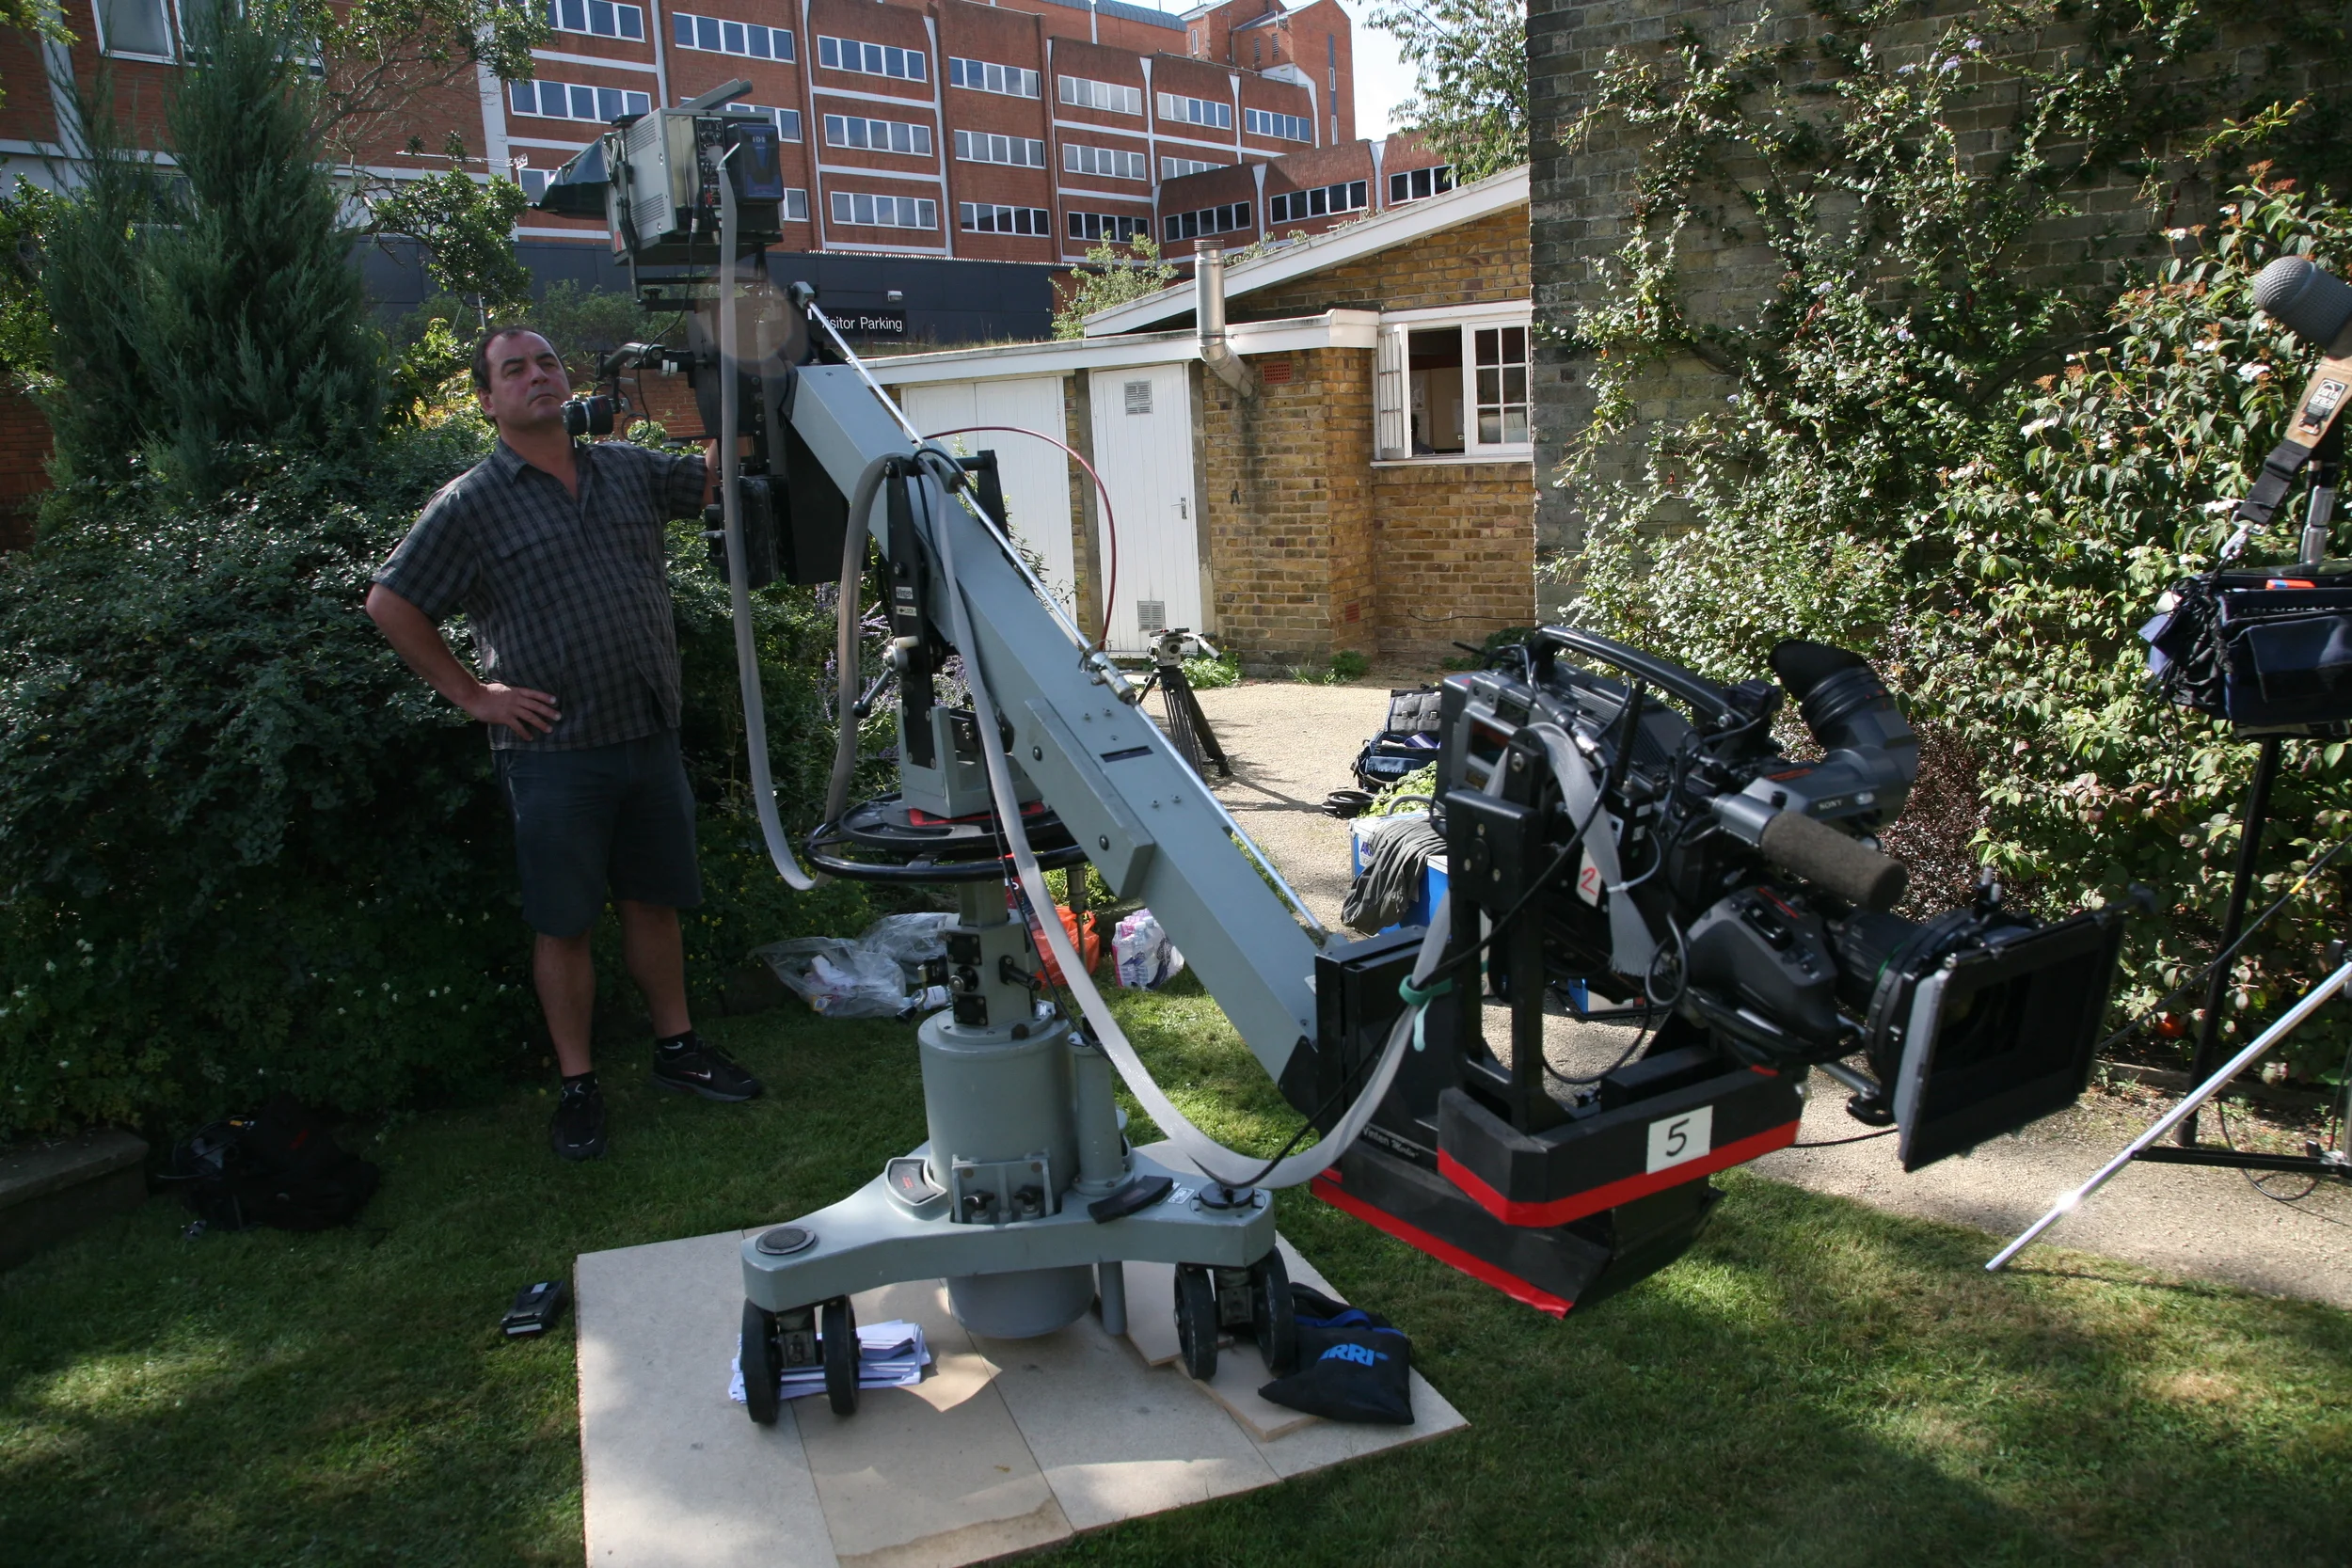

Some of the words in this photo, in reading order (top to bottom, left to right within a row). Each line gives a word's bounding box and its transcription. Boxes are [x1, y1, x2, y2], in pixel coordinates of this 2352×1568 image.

[860, 316, 903, 332] Parking
[1818, 799, 1843, 810] SONY
[1581, 866, 1597, 895] 2
[1665, 1117, 1691, 1157] 5
